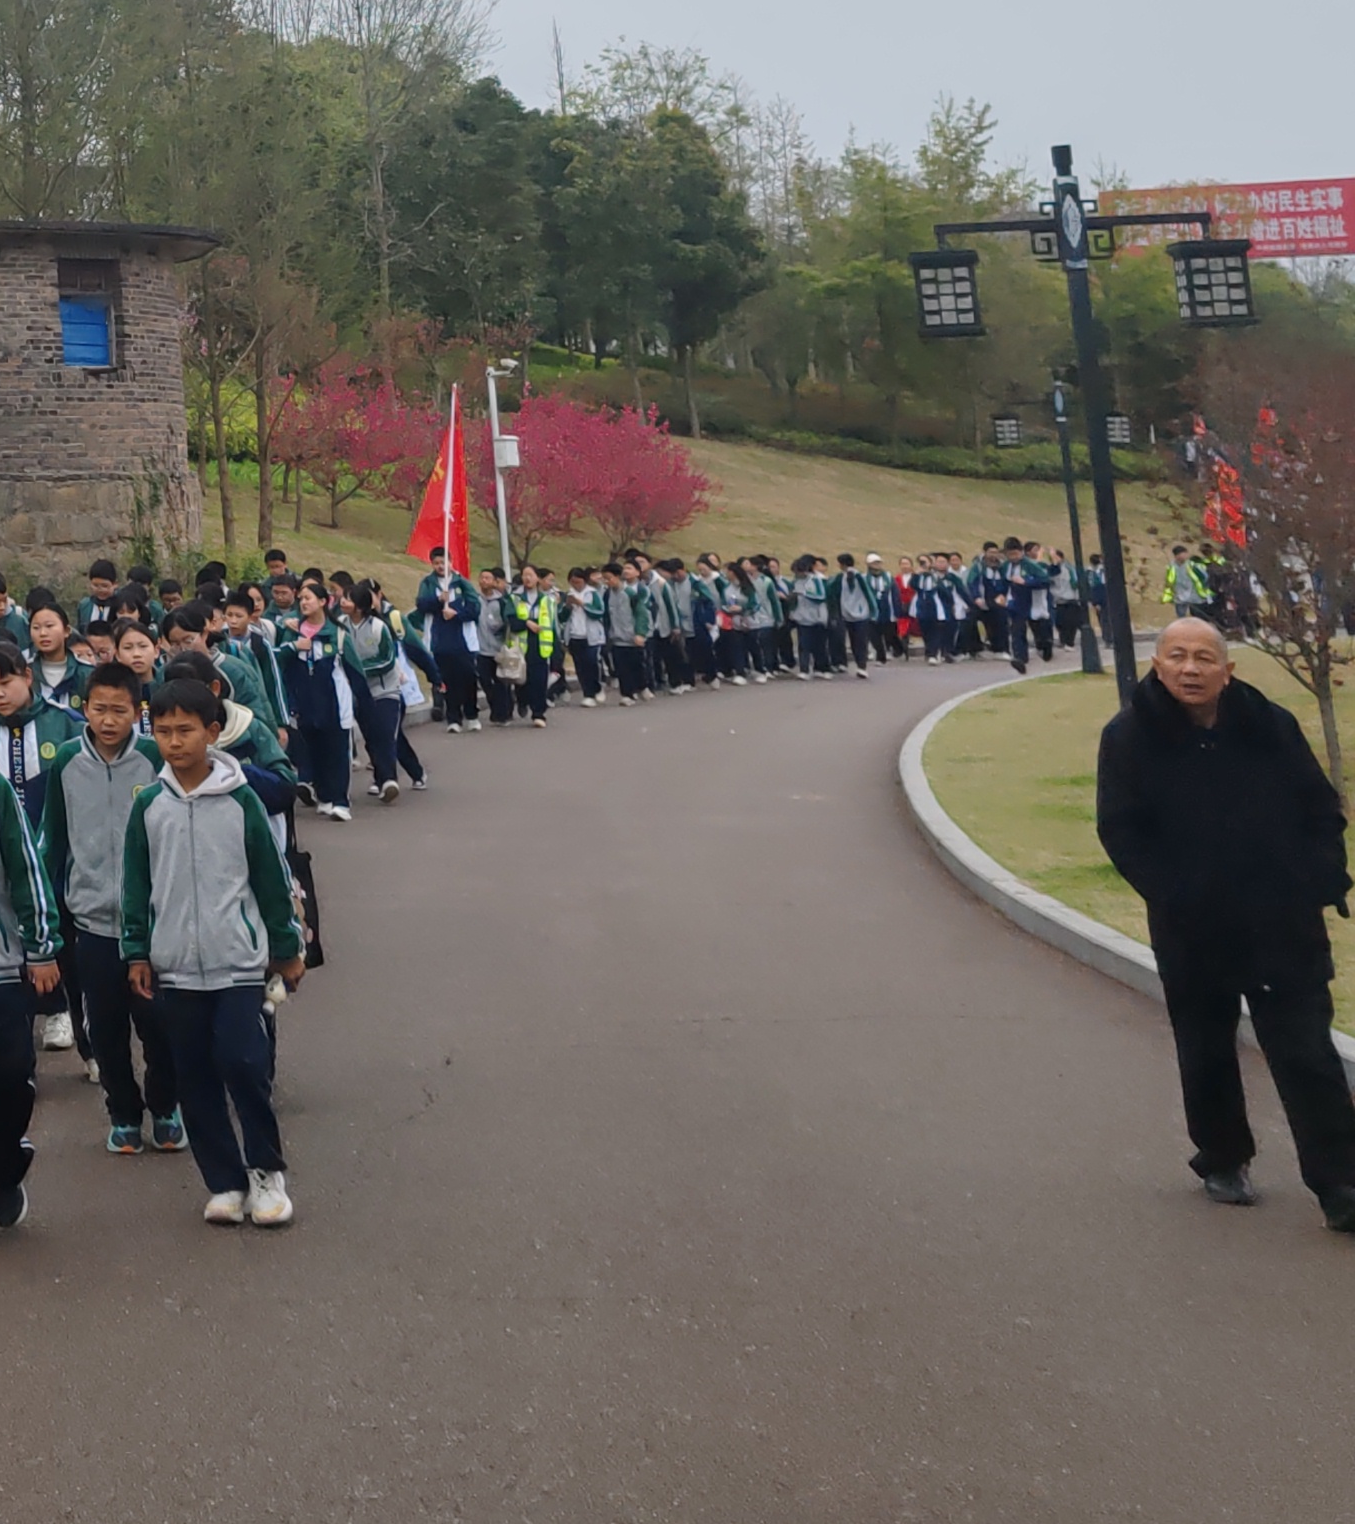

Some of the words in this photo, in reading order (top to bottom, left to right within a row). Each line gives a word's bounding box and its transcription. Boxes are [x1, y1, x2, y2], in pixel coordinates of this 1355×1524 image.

[1214, 186, 1344, 217] 办好民生实事
[12, 738, 24, 784] CHENG
